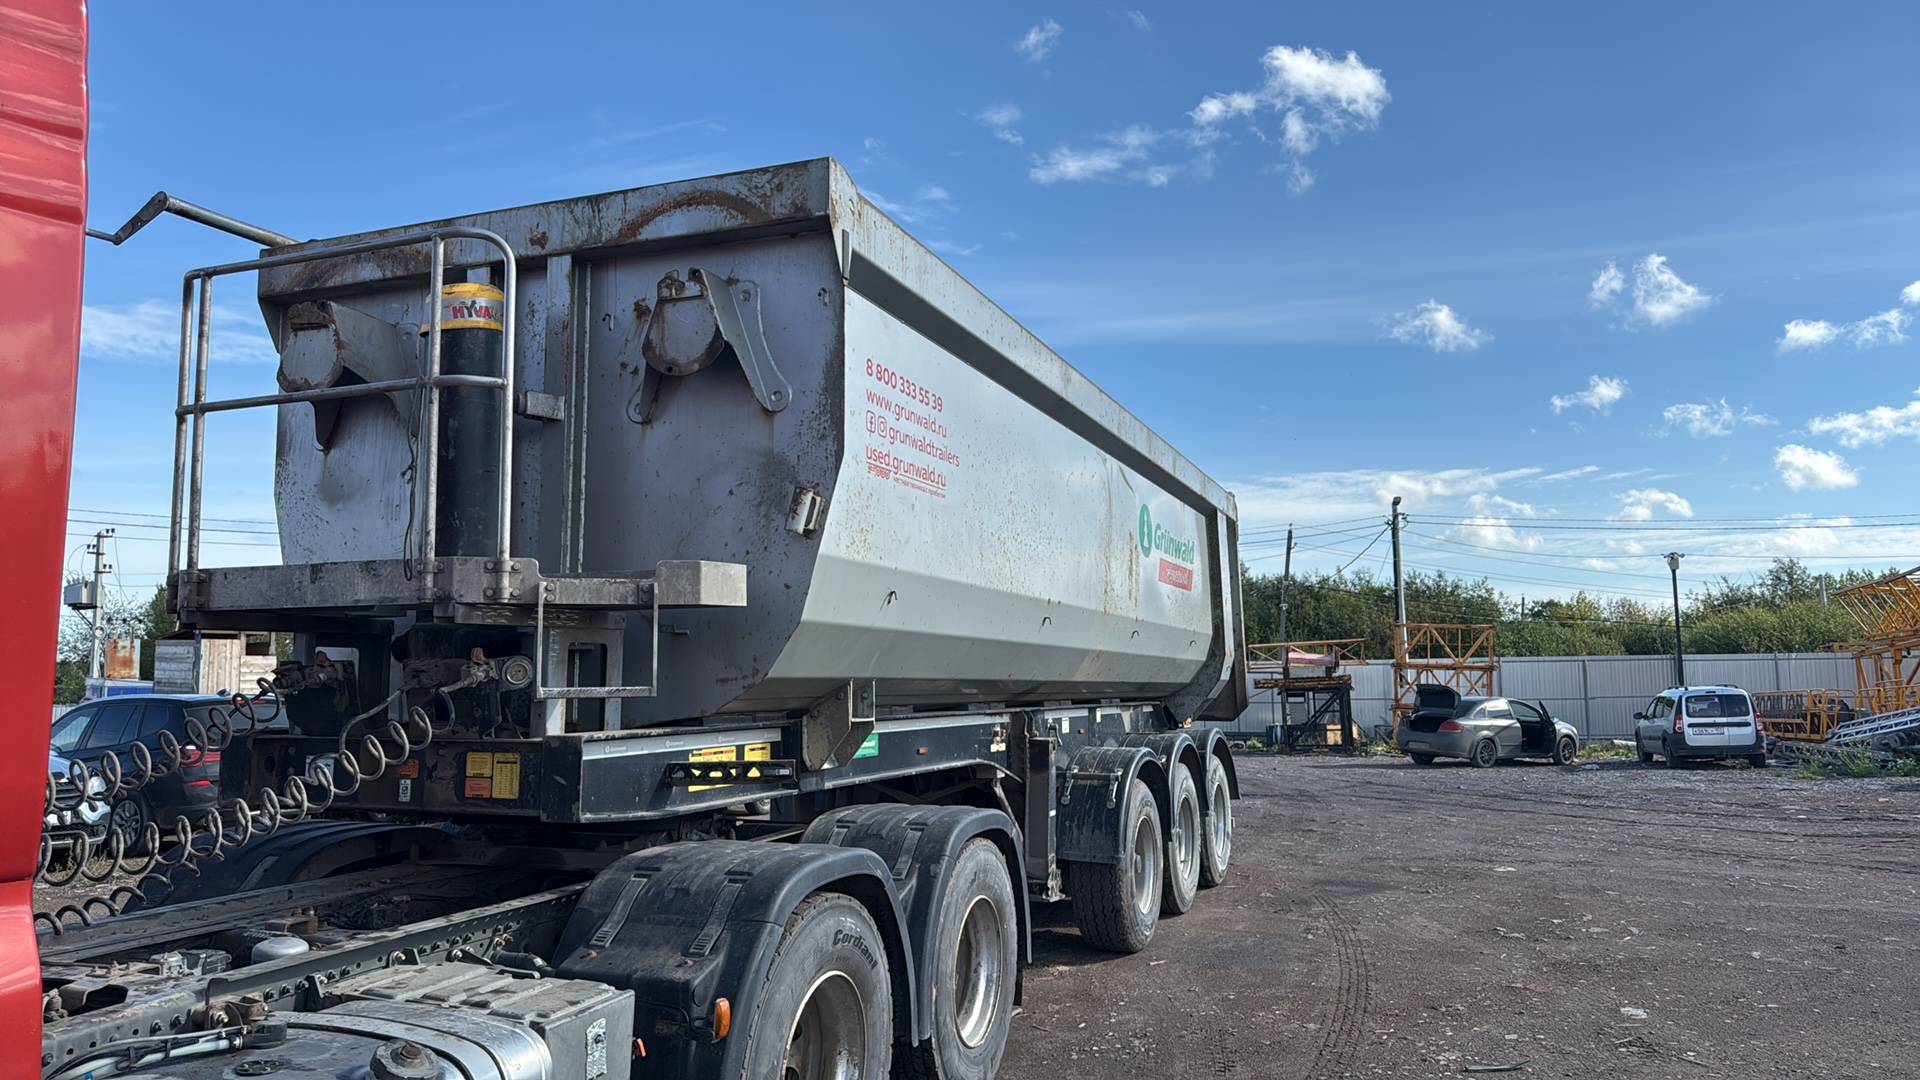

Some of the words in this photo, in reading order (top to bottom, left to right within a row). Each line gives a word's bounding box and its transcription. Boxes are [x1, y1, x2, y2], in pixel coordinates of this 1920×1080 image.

[452, 299, 494, 319] HYVA
[866, 358, 873, 377] 8
[876, 364, 897, 389] 800
[899, 376, 917, 400] 333
[919, 387, 930, 407] 55
[932, 394, 943, 413] 39
[866, 388, 947, 438] www.grunwald.ru
[866, 446, 947, 488] used.grunwald.ru
[888, 426, 961, 468] grunwaldtrailers
[1154, 523, 1195, 565] Grünwald
[832, 929, 878, 970] Cordiant
